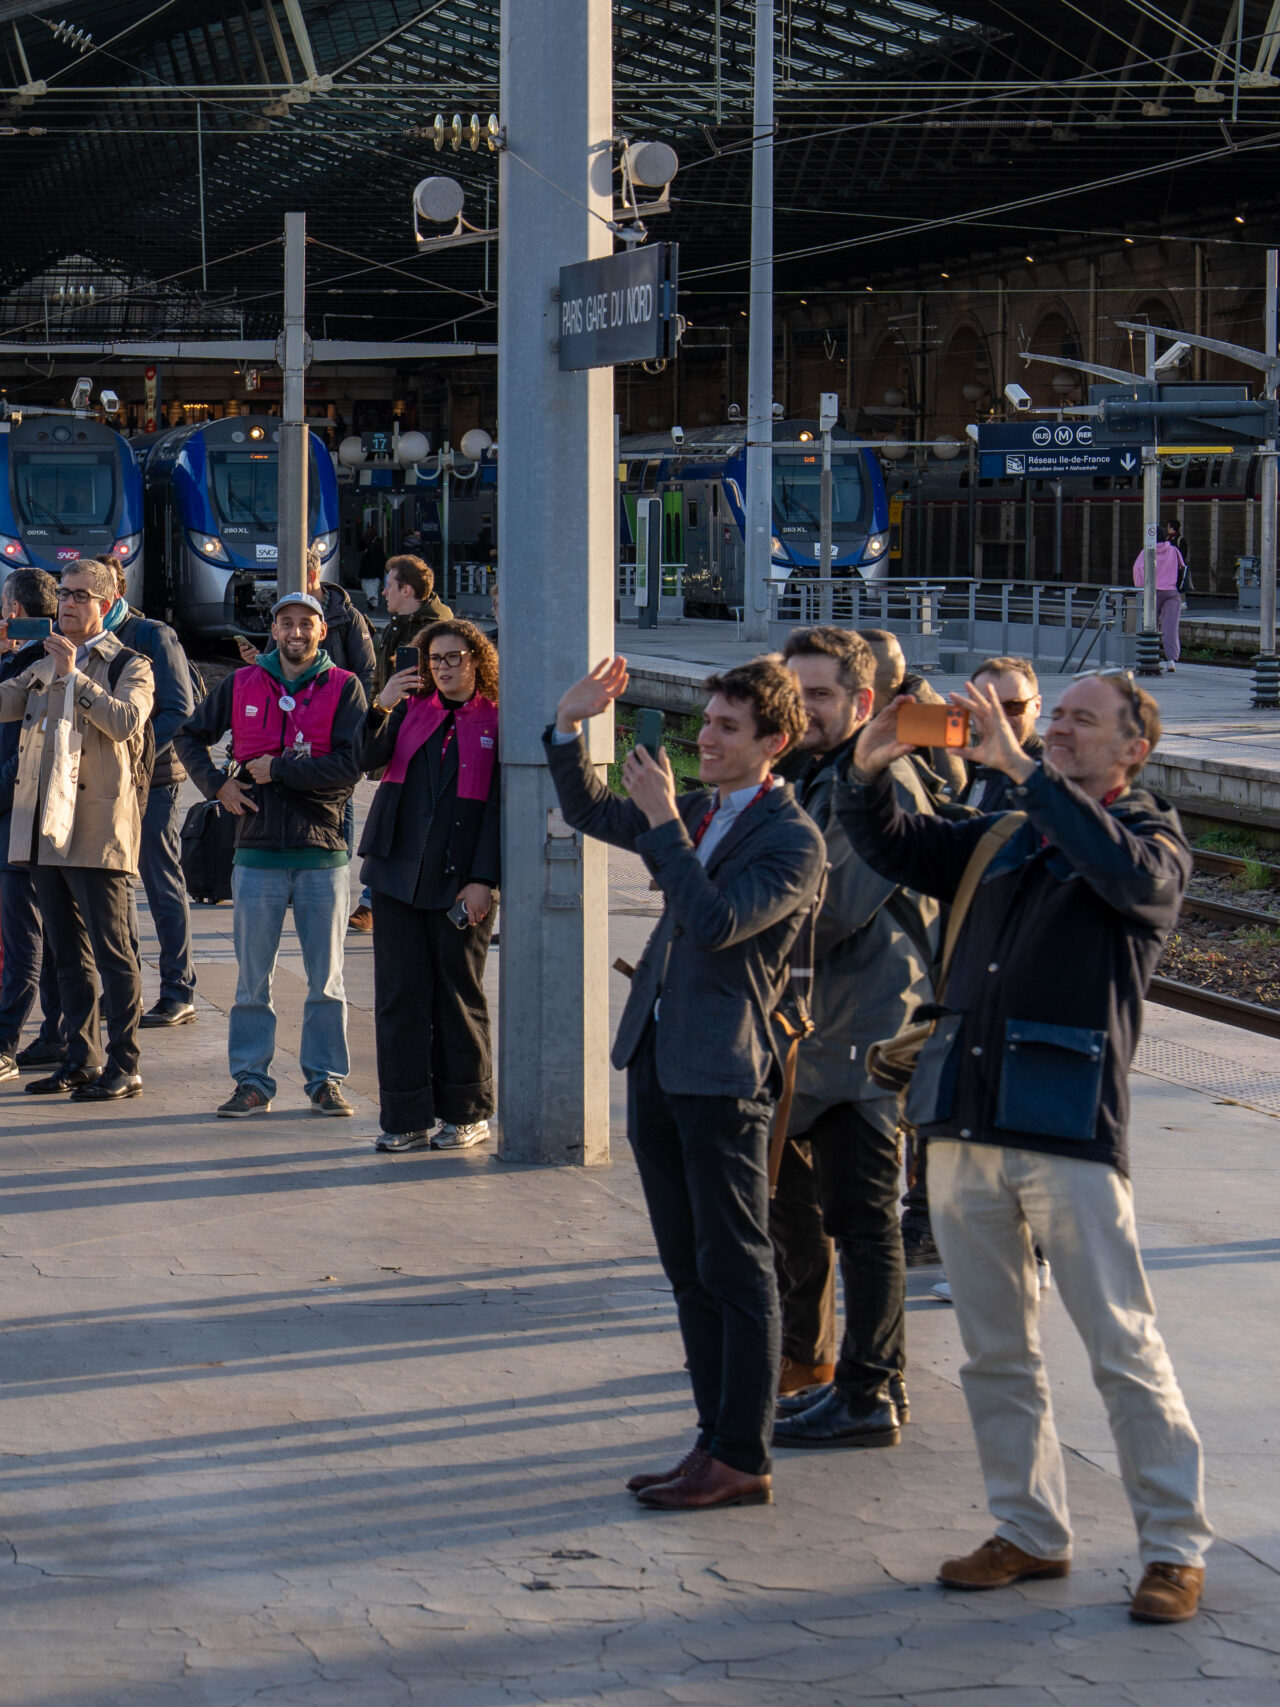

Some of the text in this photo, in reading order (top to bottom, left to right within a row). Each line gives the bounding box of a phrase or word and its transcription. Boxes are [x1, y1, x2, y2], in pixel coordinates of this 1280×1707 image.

[562, 284, 653, 336] PARIS GARE DU NORD
[1035, 432, 1049, 440] BUS
[1058, 430, 1069, 441] M
[372, 438, 387, 449] 17
[1028, 455, 1111, 464] Réseau Ile-de-France
[56, 551, 80, 559] SNCF
